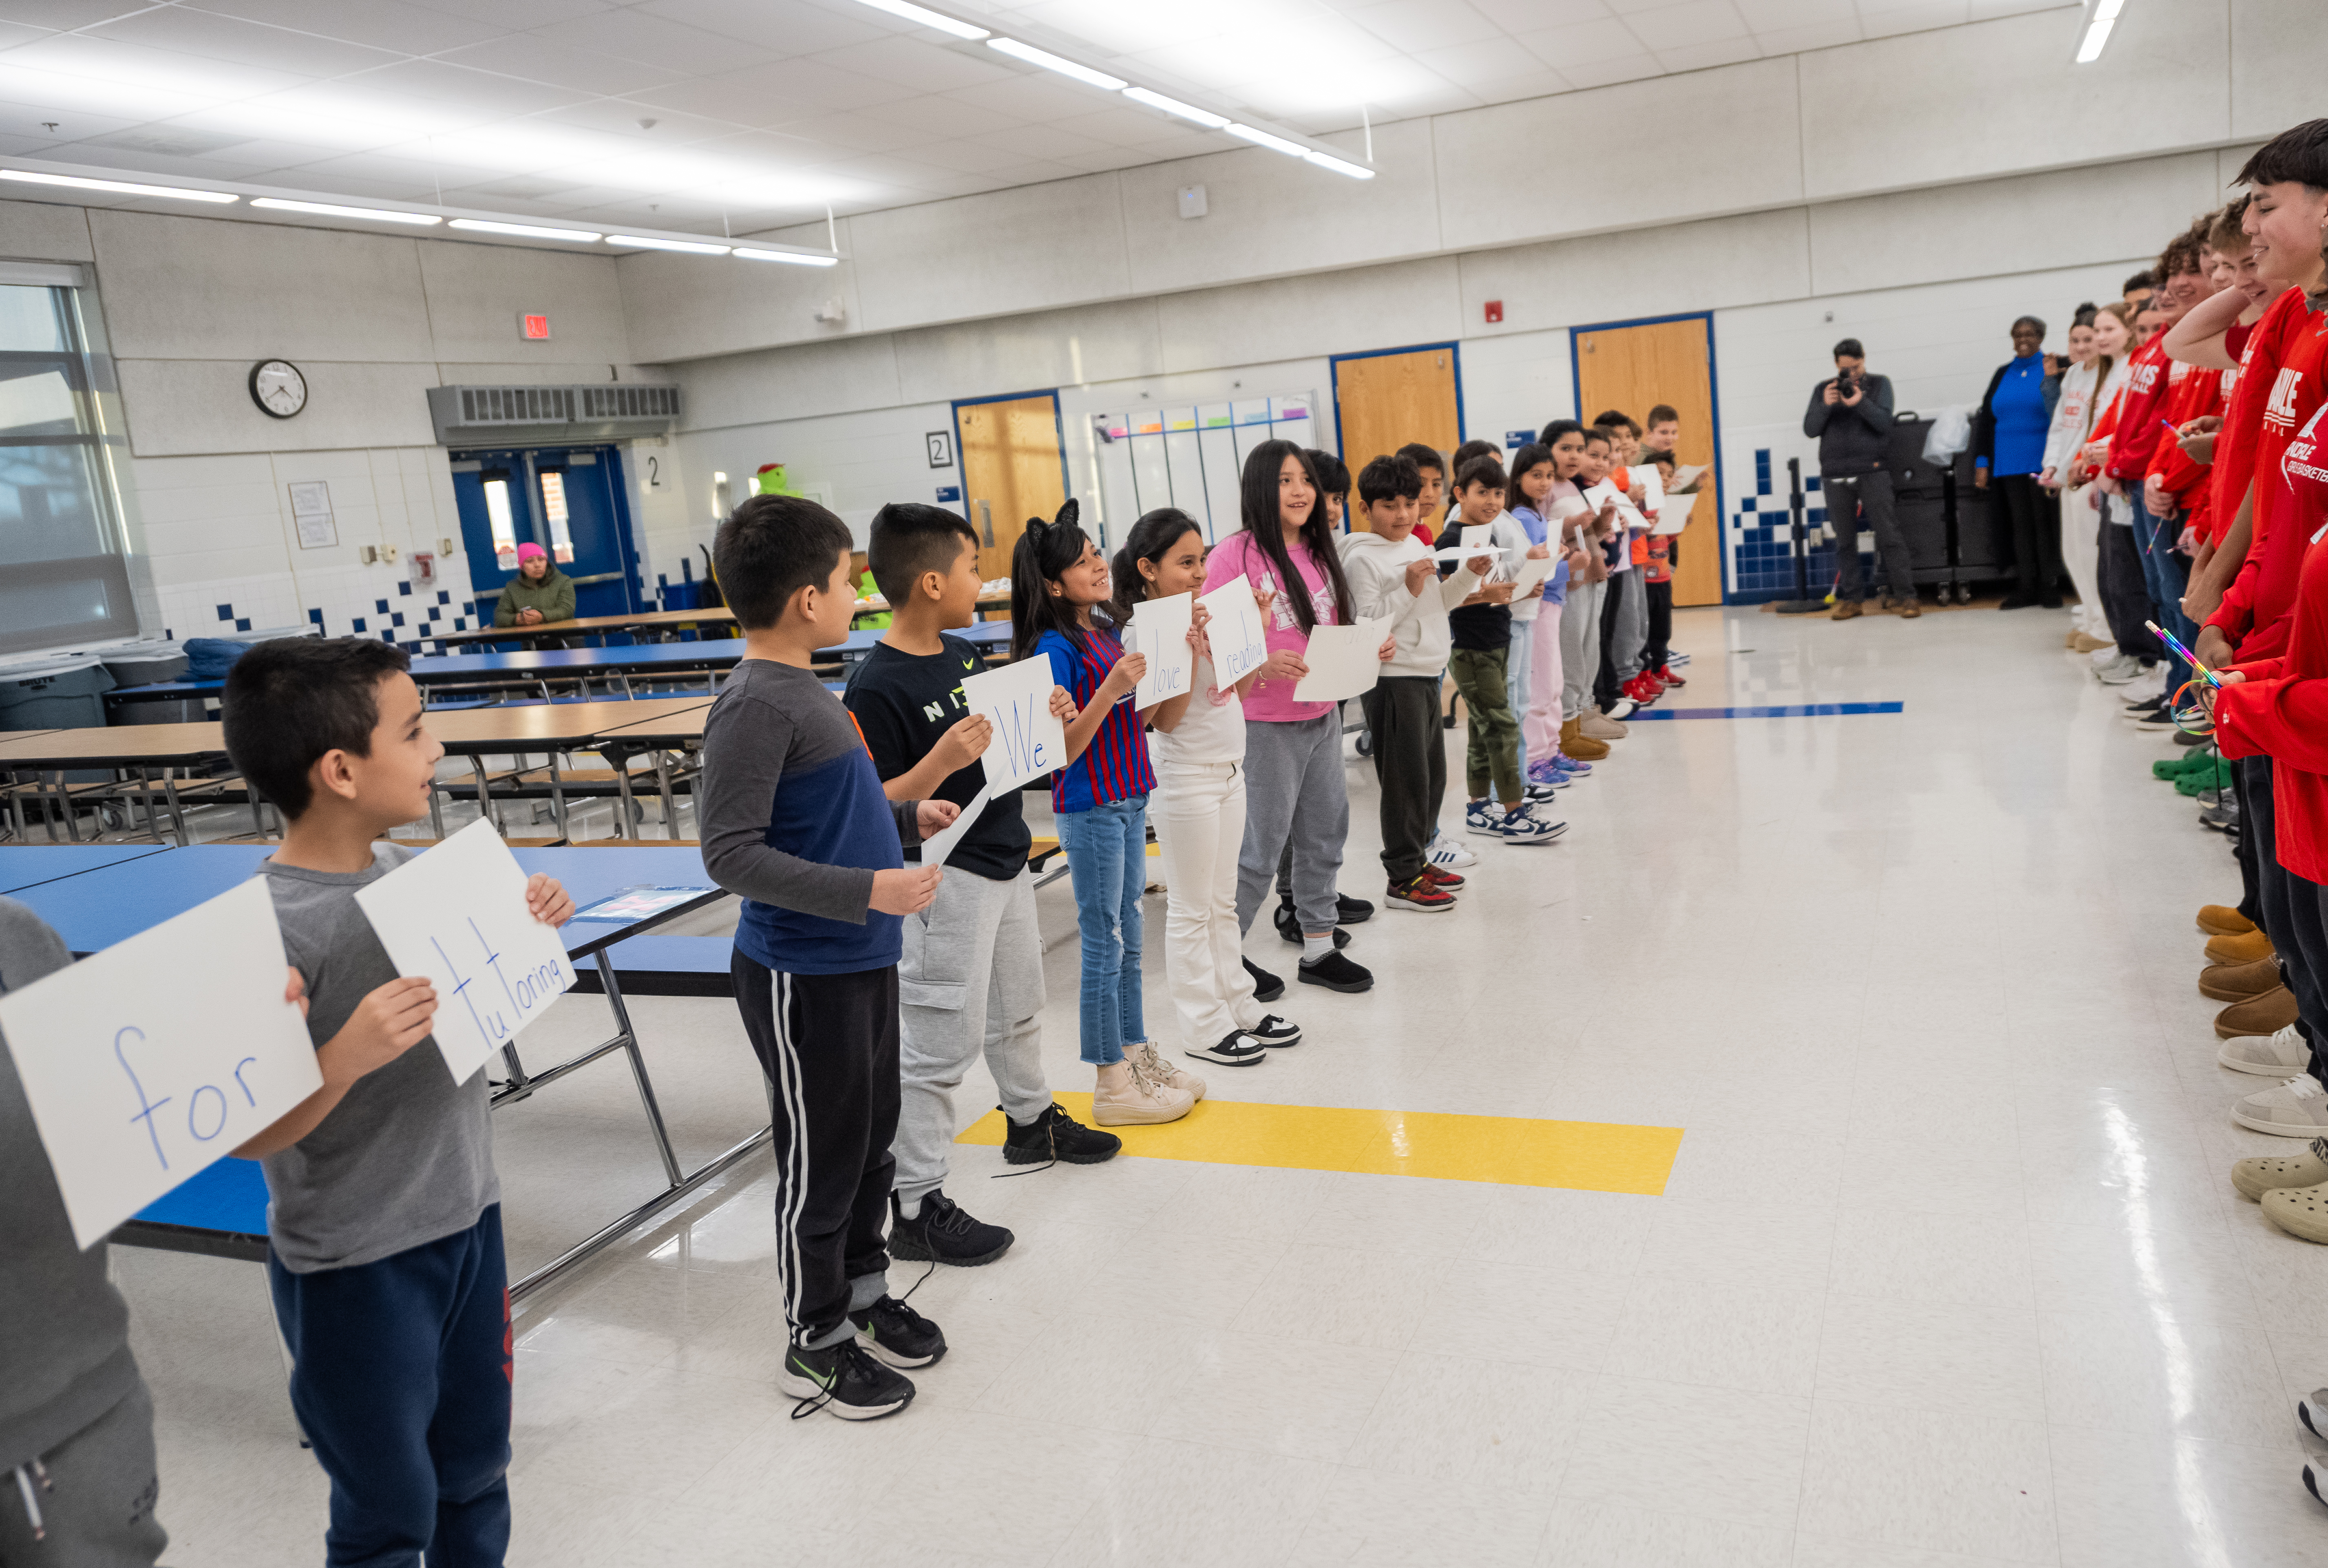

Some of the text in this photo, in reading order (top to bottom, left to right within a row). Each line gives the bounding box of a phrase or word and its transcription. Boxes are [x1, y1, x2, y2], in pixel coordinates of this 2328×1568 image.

[649, 456, 660, 486] 2
[932, 439, 944, 460] 2
[1153, 629, 1180, 696] love
[1227, 610, 1263, 678] reading
[994, 693, 1047, 777] We
[430, 917, 566, 1050] tutoring
[115, 1026, 256, 1170] for
